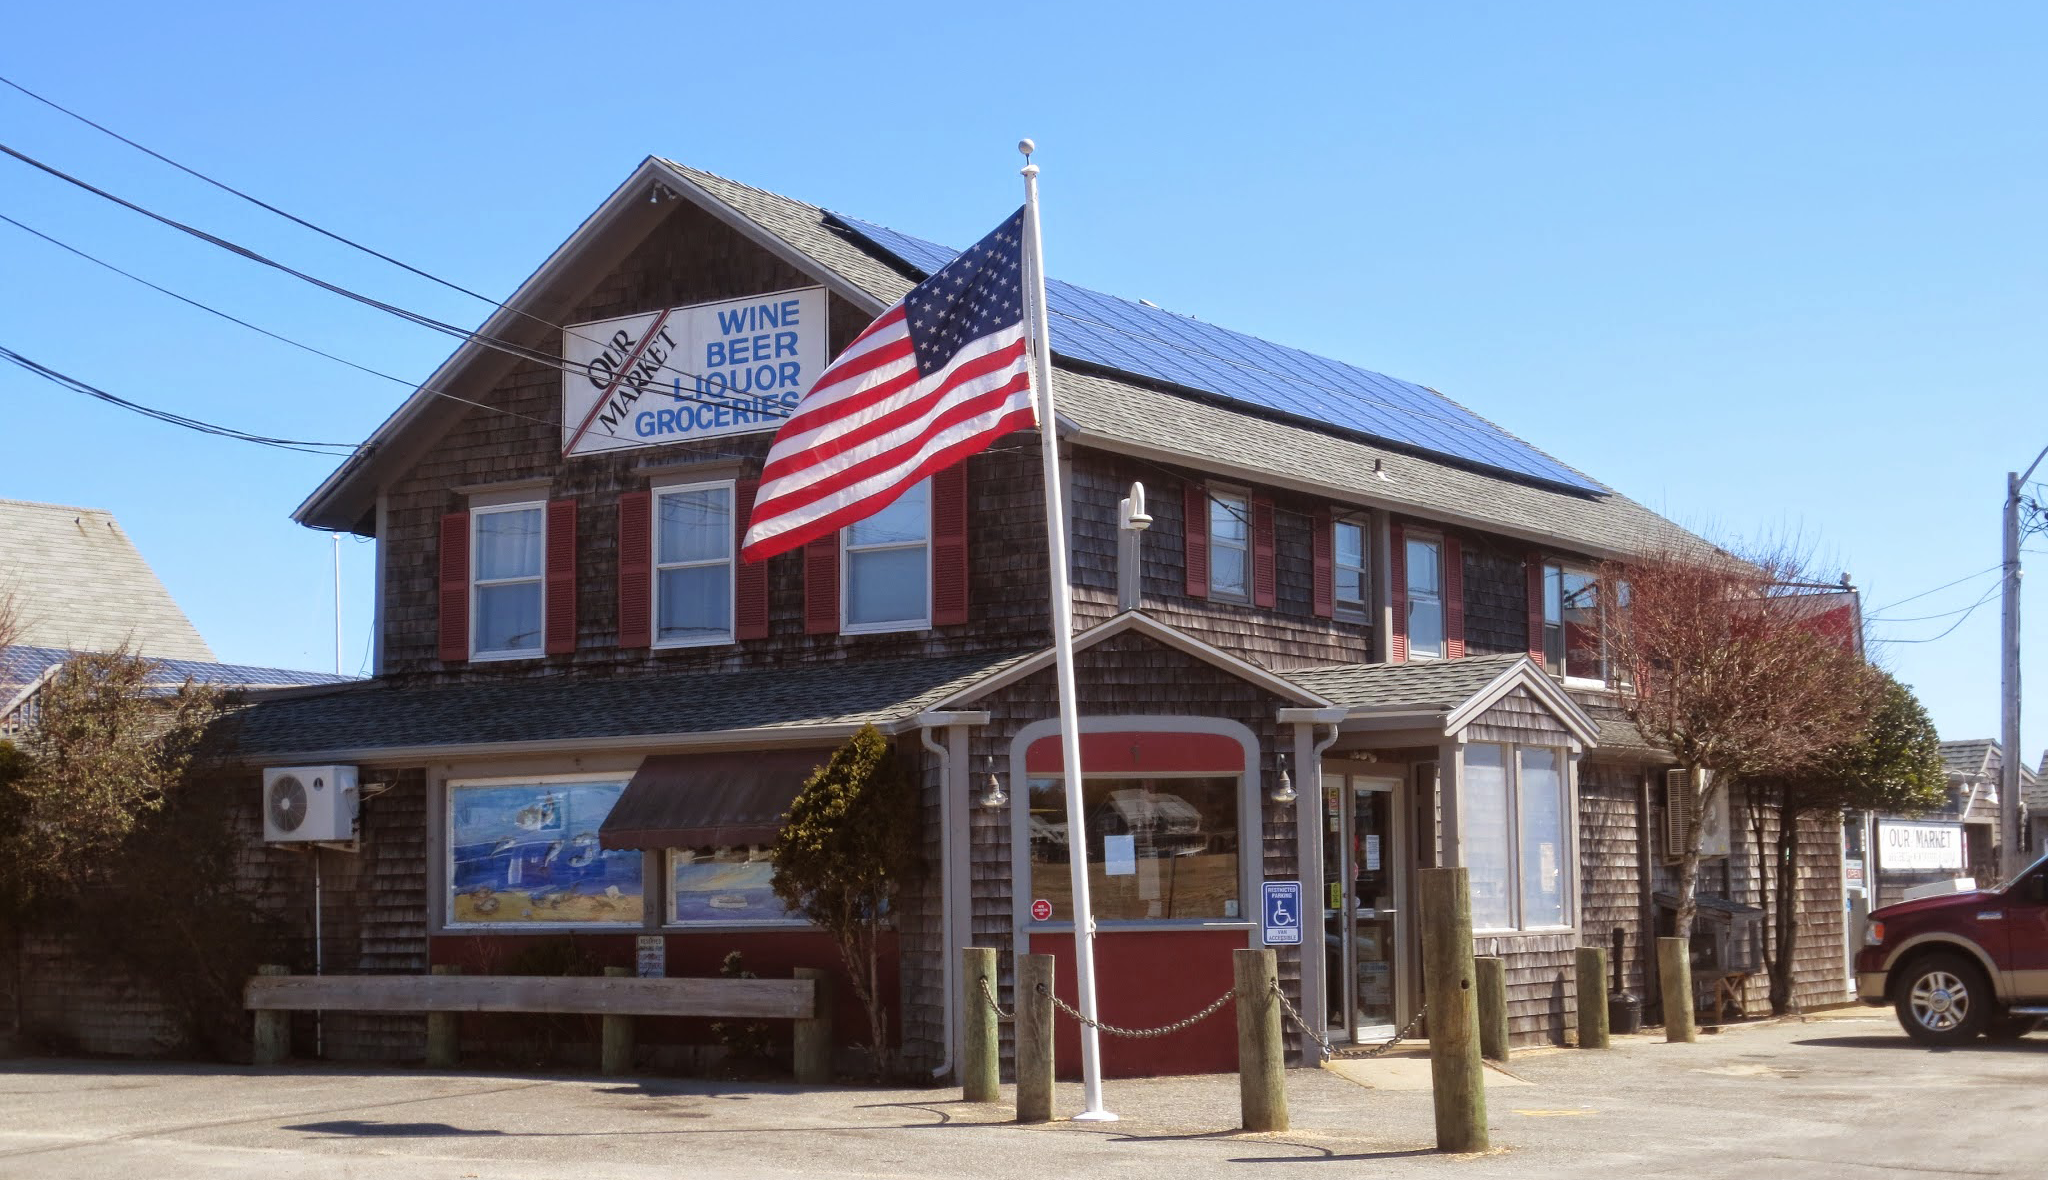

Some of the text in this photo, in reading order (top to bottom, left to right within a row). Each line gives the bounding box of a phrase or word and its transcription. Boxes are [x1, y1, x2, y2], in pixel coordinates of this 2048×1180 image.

[717, 299, 800, 336] WINE
[587, 329, 638, 390] OUR
[706, 331, 799, 369] BEER
[598, 324, 677, 436] MARKET
[673, 361, 801, 402] LIQUOR
[635, 391, 800, 438] GROCERIES
[1889, 828, 1952, 849] OUR MARKET
